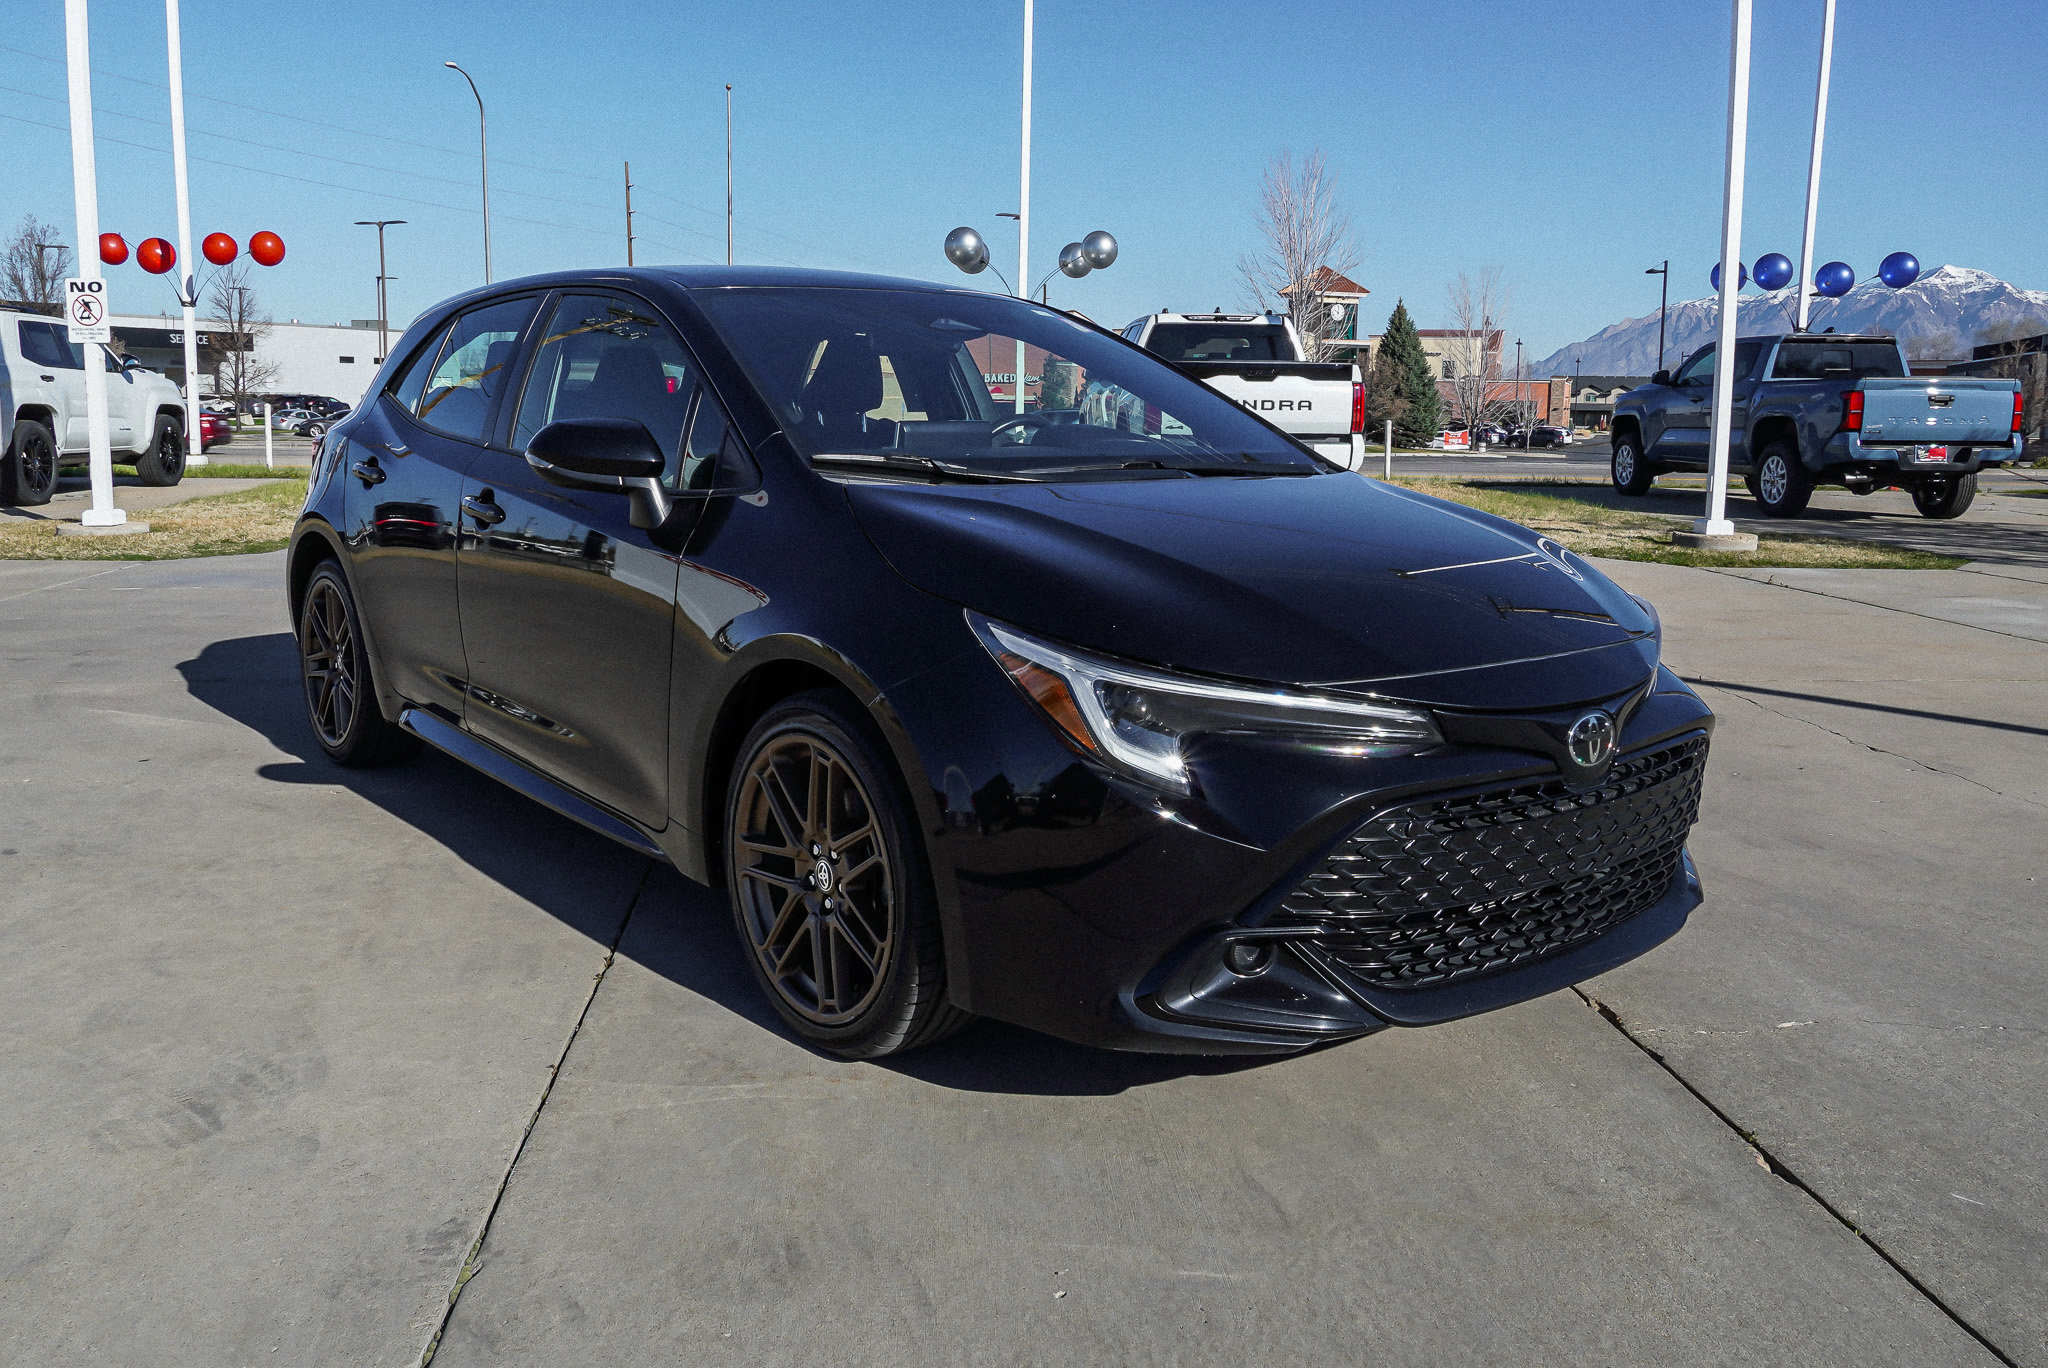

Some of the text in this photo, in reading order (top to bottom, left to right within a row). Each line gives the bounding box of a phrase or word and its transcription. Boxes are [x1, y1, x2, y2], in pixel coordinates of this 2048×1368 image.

[70, 281, 102, 293] NO
[169, 333, 209, 345] SECE
[984, 373, 1016, 383] BAKED
[1235, 400, 1312, 411] NDRA
